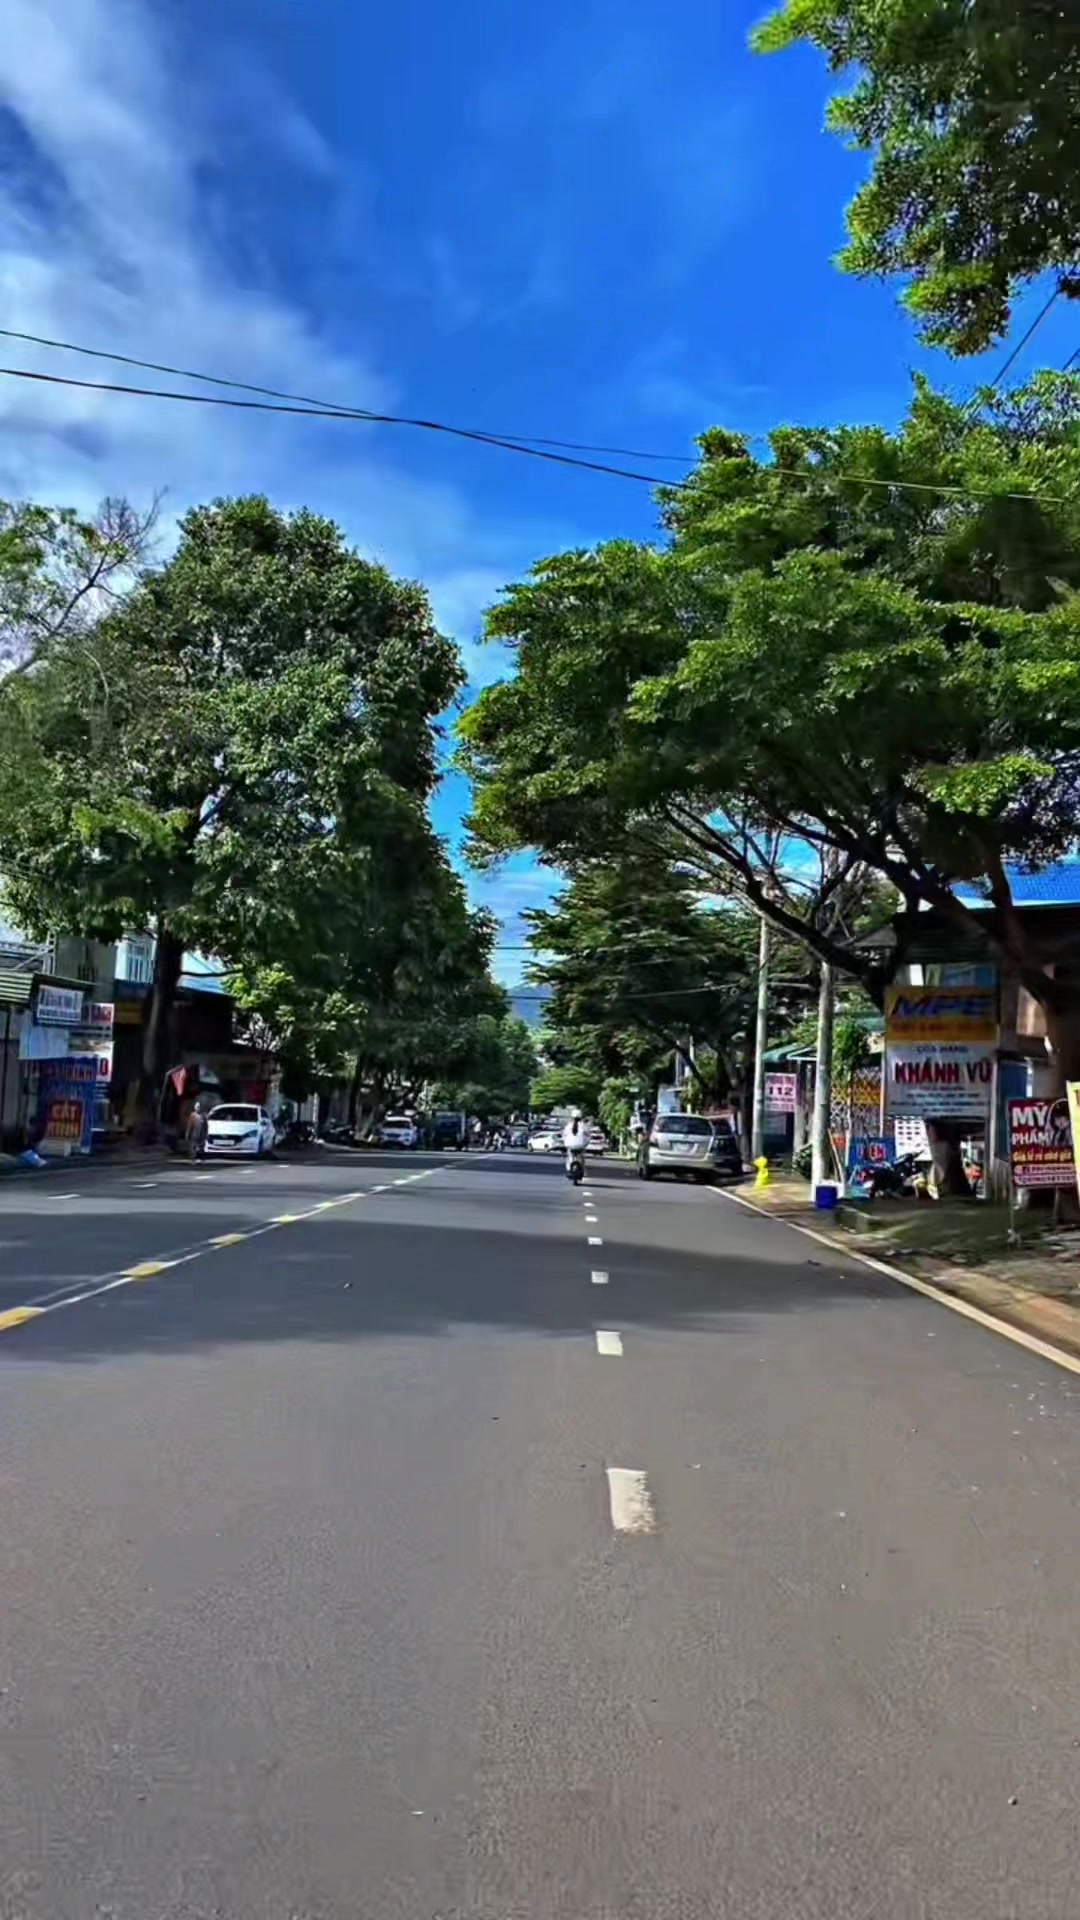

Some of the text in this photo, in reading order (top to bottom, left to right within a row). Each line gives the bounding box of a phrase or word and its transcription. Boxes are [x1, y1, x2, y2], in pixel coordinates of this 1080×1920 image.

[895, 1057, 993, 1084] KHÁNH VŨ
[1012, 1102, 1048, 1127] MỸ
